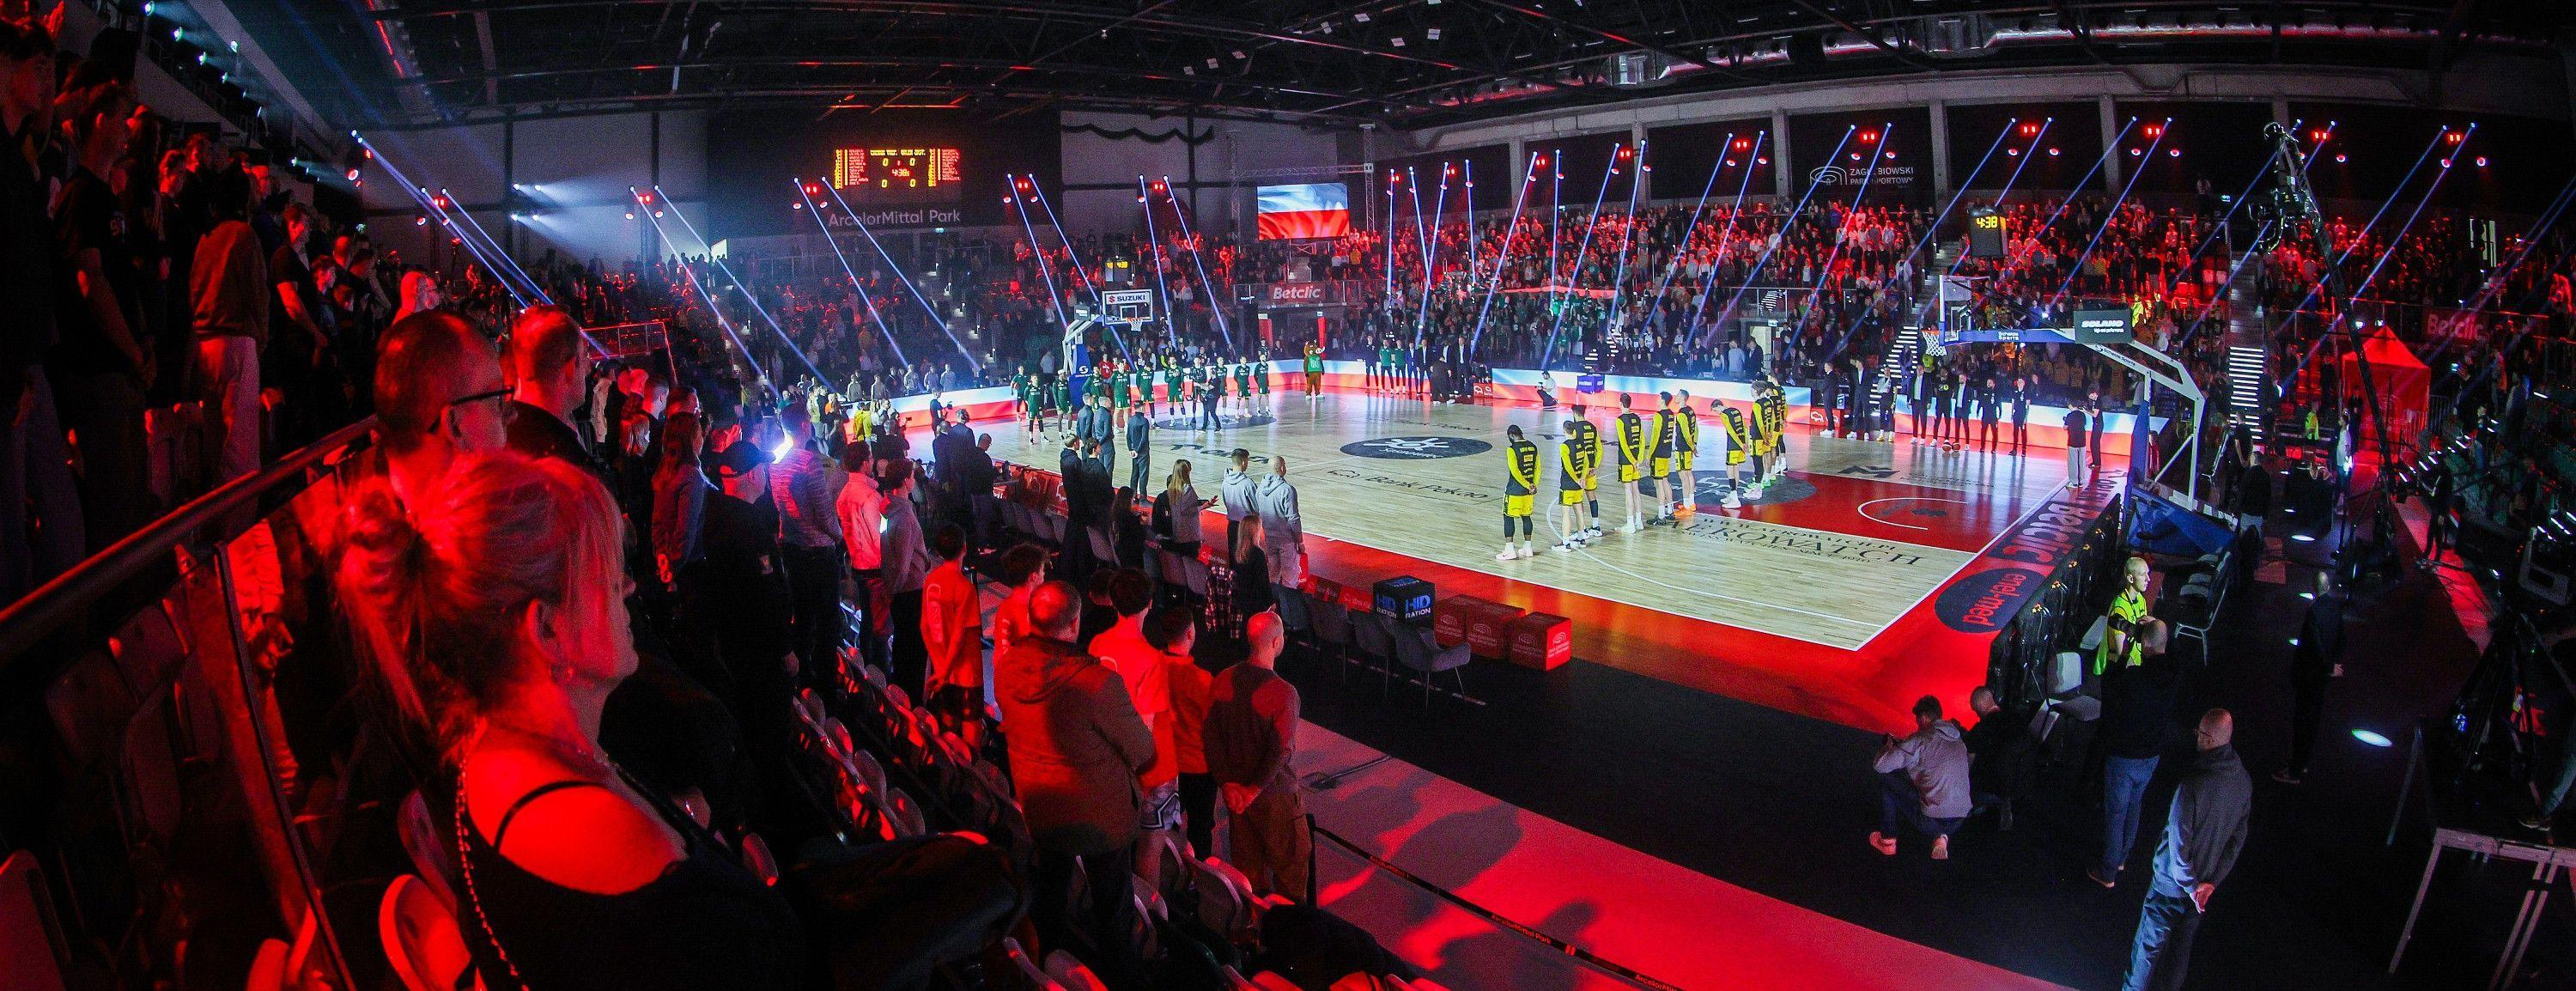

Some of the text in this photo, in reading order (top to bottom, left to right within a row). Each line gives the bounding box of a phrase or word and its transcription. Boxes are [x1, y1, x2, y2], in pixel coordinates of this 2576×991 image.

[1850, 167, 1914, 176] ZAGBIOWSKI
[929, 210, 960, 222] Park
[1976, 216, 1998, 228] 4:38
[1273, 285, 1321, 300] Betclic
[2427, 313, 2484, 341] Beclic
[2002, 502, 2103, 563] Betclic
[1962, 573, 2027, 627] enel-med
[1405, 607, 1431, 619] RATION
